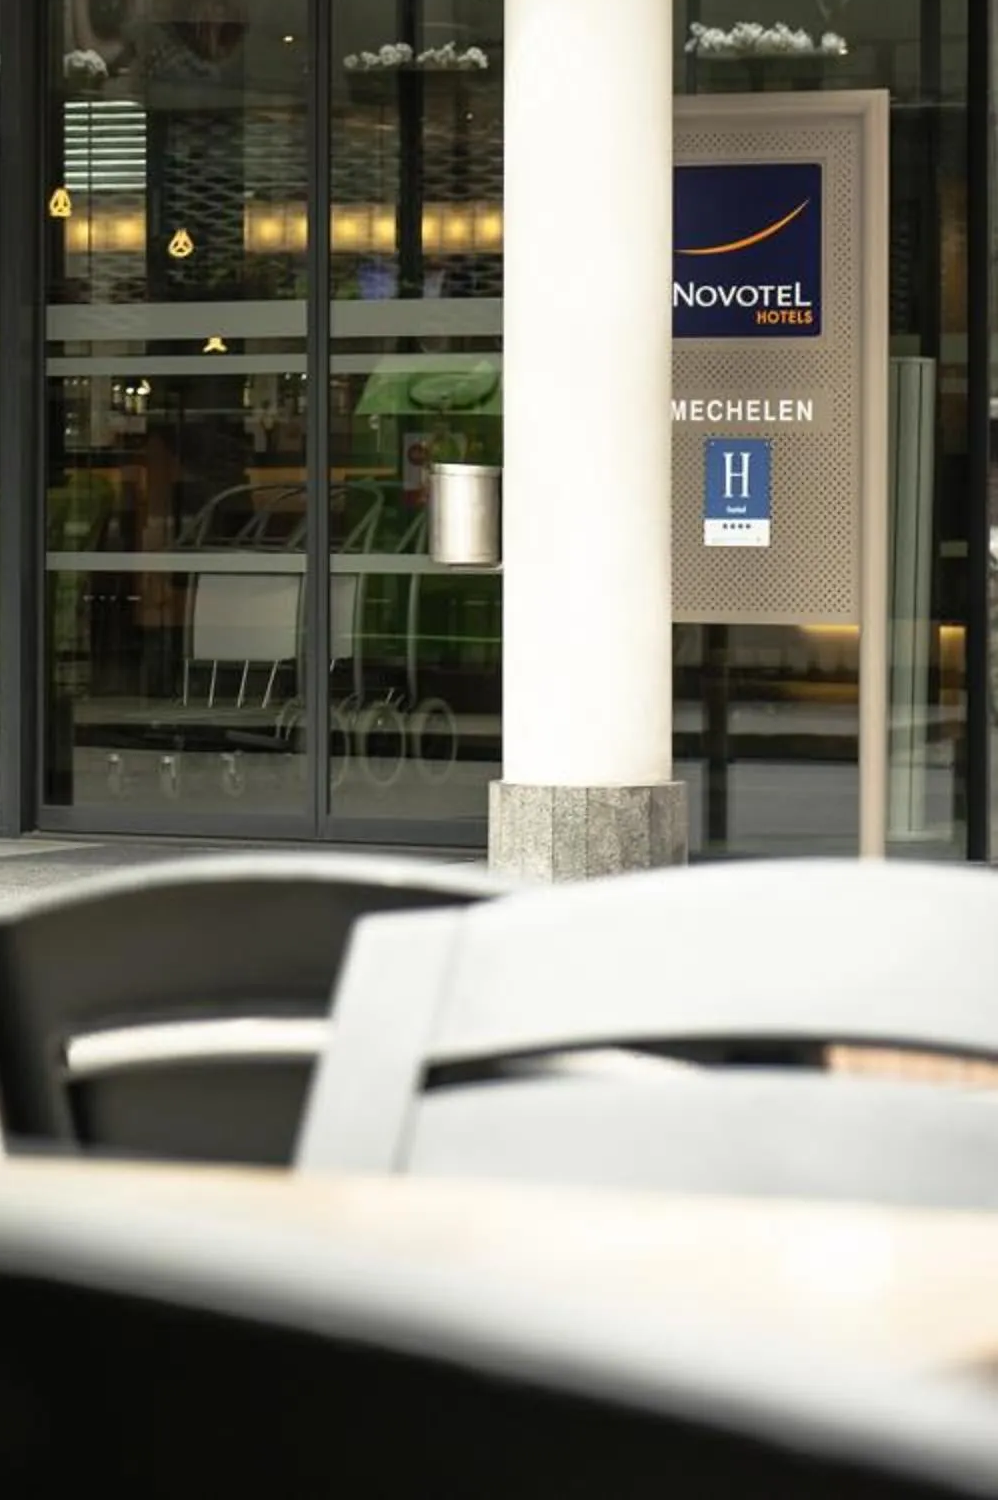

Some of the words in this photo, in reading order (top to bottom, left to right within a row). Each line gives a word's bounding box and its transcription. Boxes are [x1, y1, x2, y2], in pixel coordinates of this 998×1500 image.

[673, 282, 812, 307] NOVOTEL
[756, 310, 813, 324] HOTELS
[670, 399, 813, 421] MECHELEN
[723, 452, 751, 498] H
